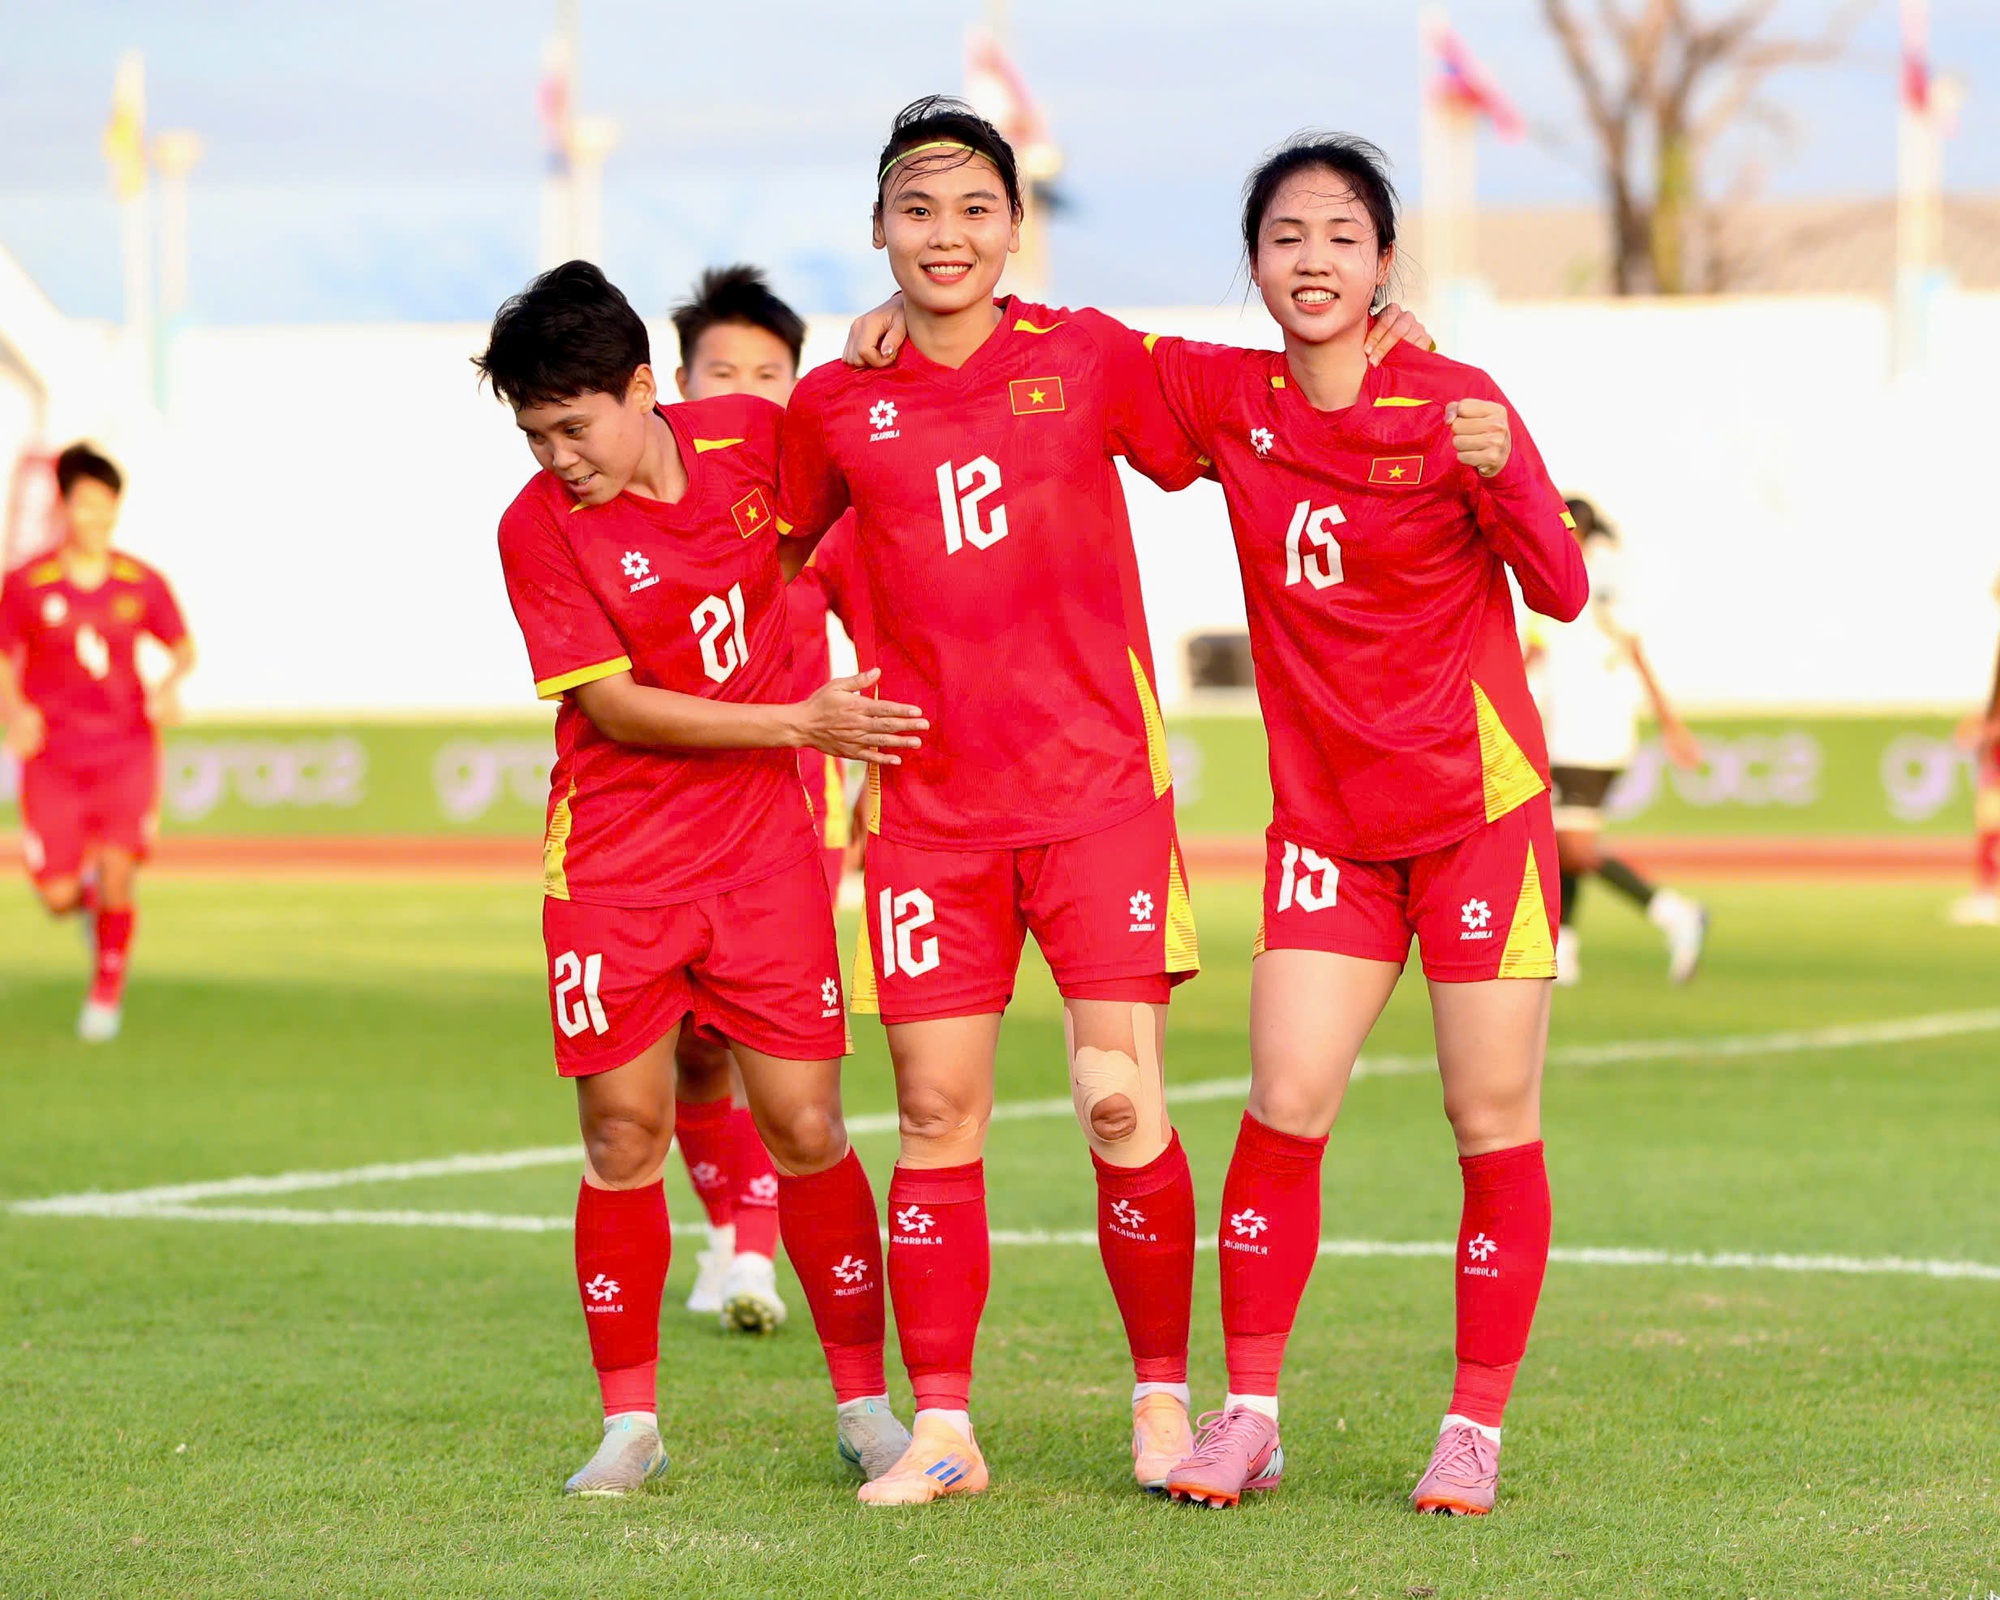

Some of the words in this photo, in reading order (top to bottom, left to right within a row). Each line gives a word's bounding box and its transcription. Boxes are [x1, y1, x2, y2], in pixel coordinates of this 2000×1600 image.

[936, 454, 1009, 556] 12
[1285, 499, 1347, 590] 15
[689, 581, 749, 684] 21
[1277, 839, 1340, 913] 15
[879, 886, 941, 979] 12
[554, 949, 610, 1039] 21
